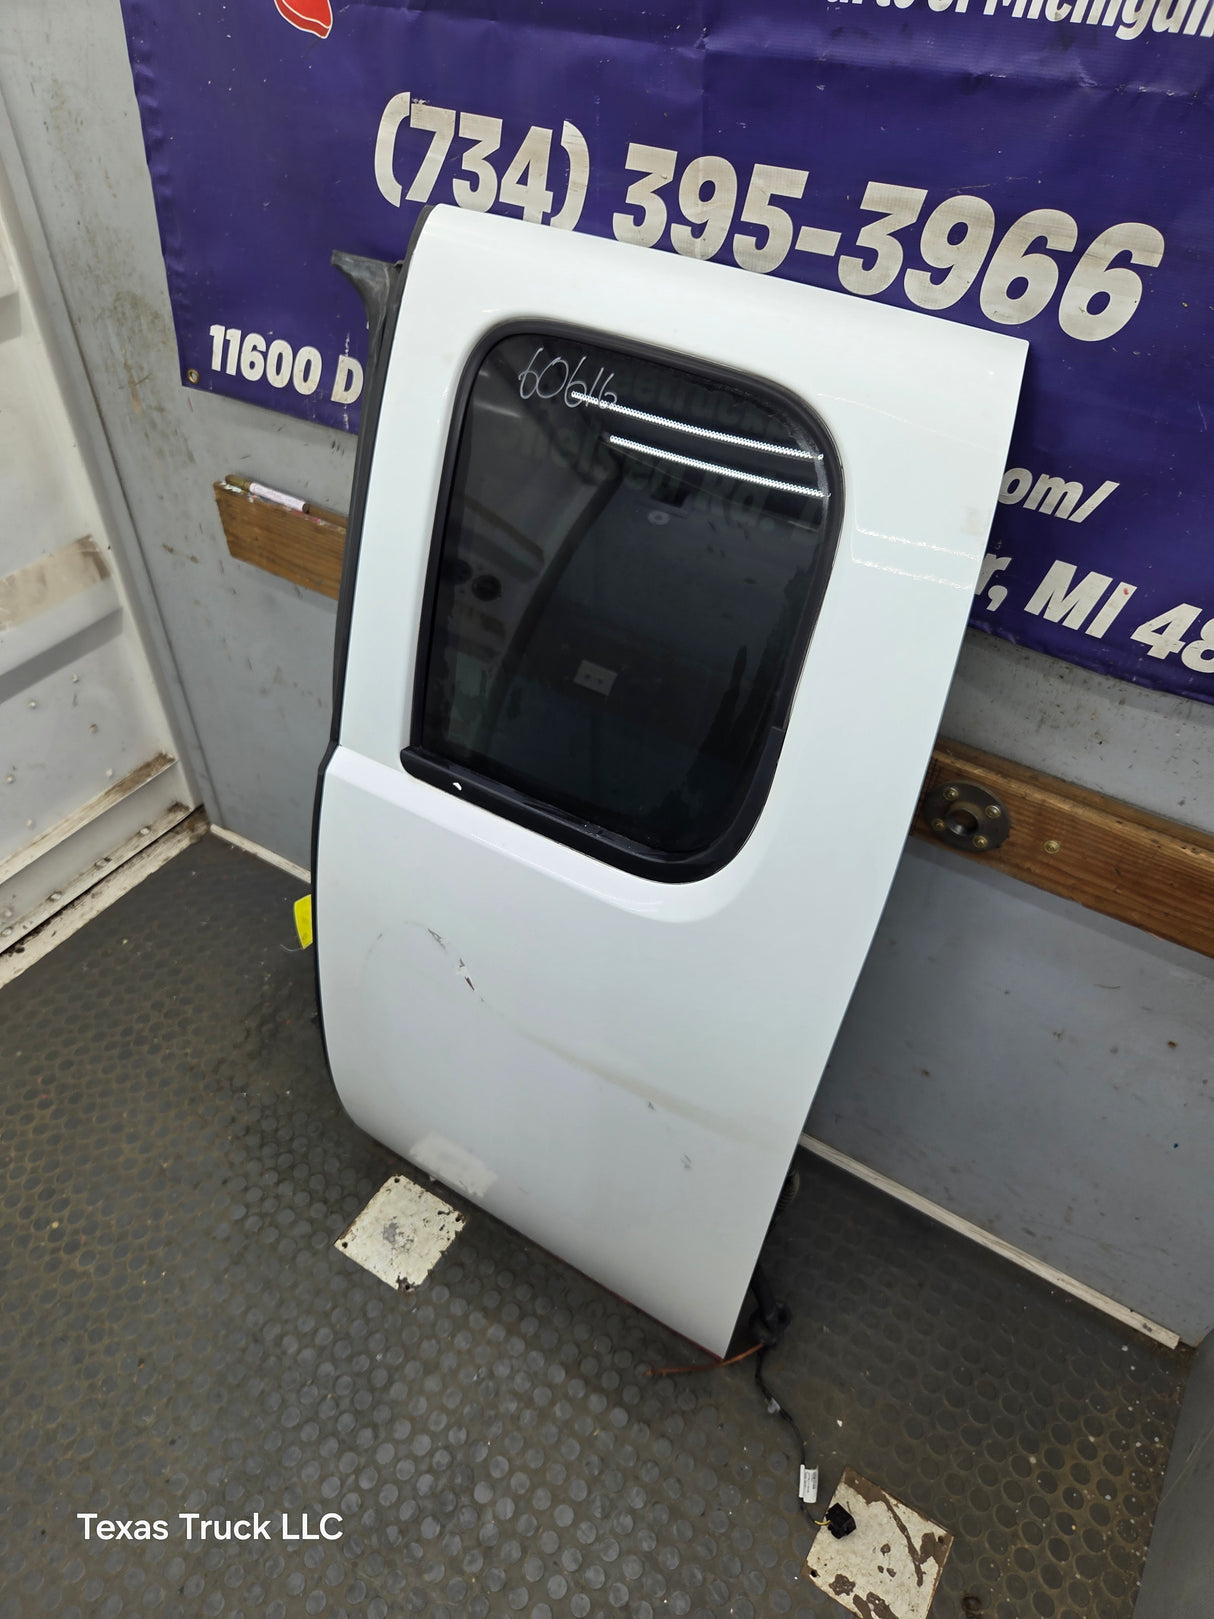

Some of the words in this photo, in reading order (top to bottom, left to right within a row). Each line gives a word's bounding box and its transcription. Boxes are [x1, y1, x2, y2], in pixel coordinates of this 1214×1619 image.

[983, 0, 1214, 40] cgan
[374, 91, 590, 232] (734)
[612, 142, 1165, 342] 395-3966
[518, 347, 618, 408] 60616
[209, 324, 323, 396] 11600
[1023, 559, 1138, 639] MI
